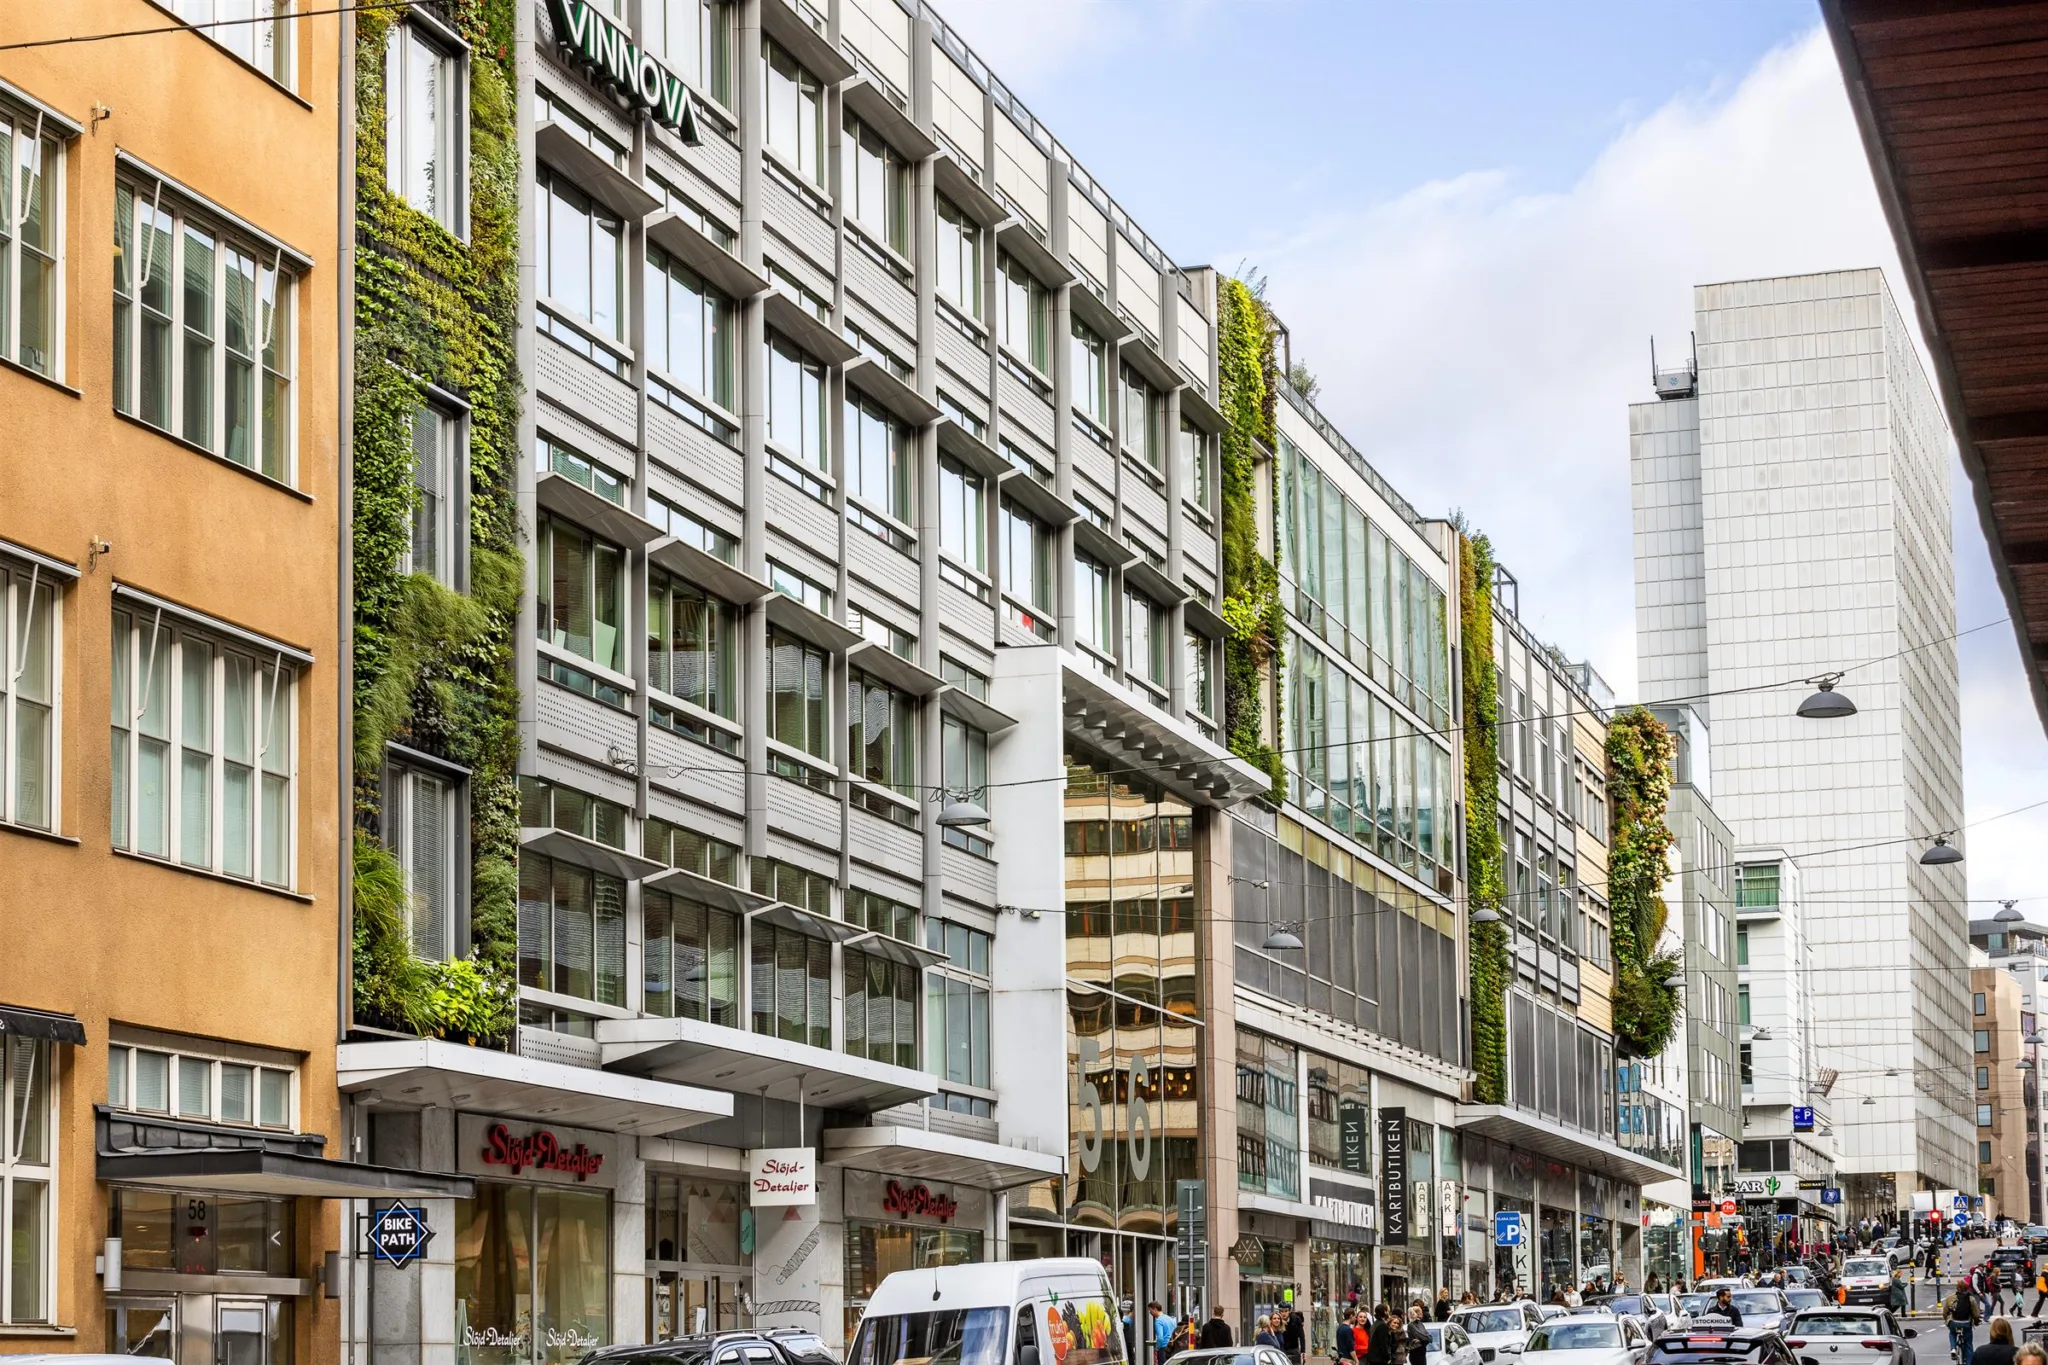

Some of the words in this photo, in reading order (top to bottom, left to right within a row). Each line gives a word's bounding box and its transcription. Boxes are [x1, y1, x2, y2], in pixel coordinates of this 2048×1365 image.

[559, 0, 703, 144] VINNOVA
[1078, 1037, 1151, 1182] 56
[481, 1123, 605, 1182] Slöjd-Detaljer
[761, 1159, 805, 1177] Slöjd-
[1387, 1119, 1402, 1234] KARTBUTIKEN
[753, 1178, 809, 1194] Detaljer
[188, 1199, 206, 1220] 58
[384, 1217, 412, 1231] BIKE
[1506, 1224, 1519, 1241] P
[381, 1232, 416, 1246] PATH
[463, 1325, 521, 1354] Slöjd-Detaljer
[545, 1327, 600, 1351] Slöjd-Detaljer
